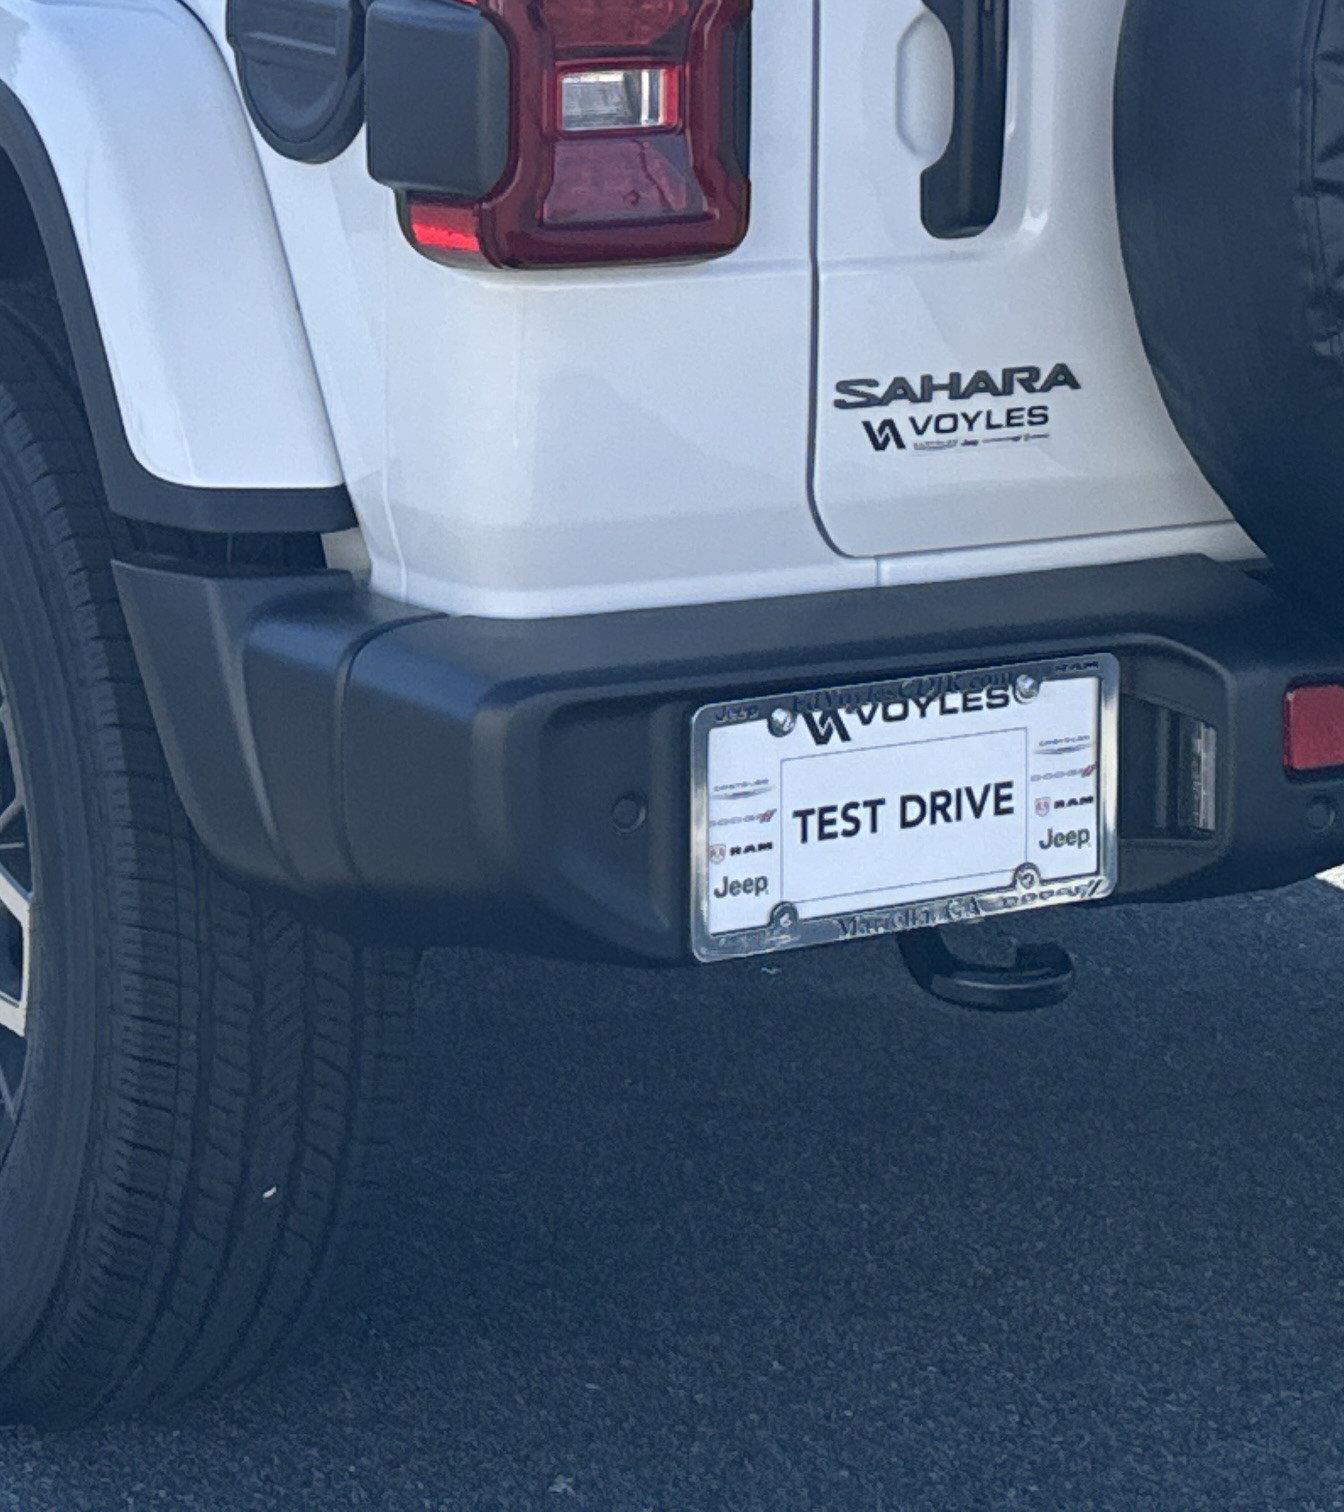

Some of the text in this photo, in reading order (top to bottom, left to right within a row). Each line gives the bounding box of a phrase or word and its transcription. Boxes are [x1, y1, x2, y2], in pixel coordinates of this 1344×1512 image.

[833, 362, 1082, 409] SAHARA
[909, 405, 1049, 436] VOYLES
[857, 686, 1010, 726] VOYLES
[793, 780, 1015, 845] TEST DRIVE
[729, 841, 773, 857] RAM
[1038, 828, 1090, 850] Jeep
[713, 875, 768, 899] Jeep
